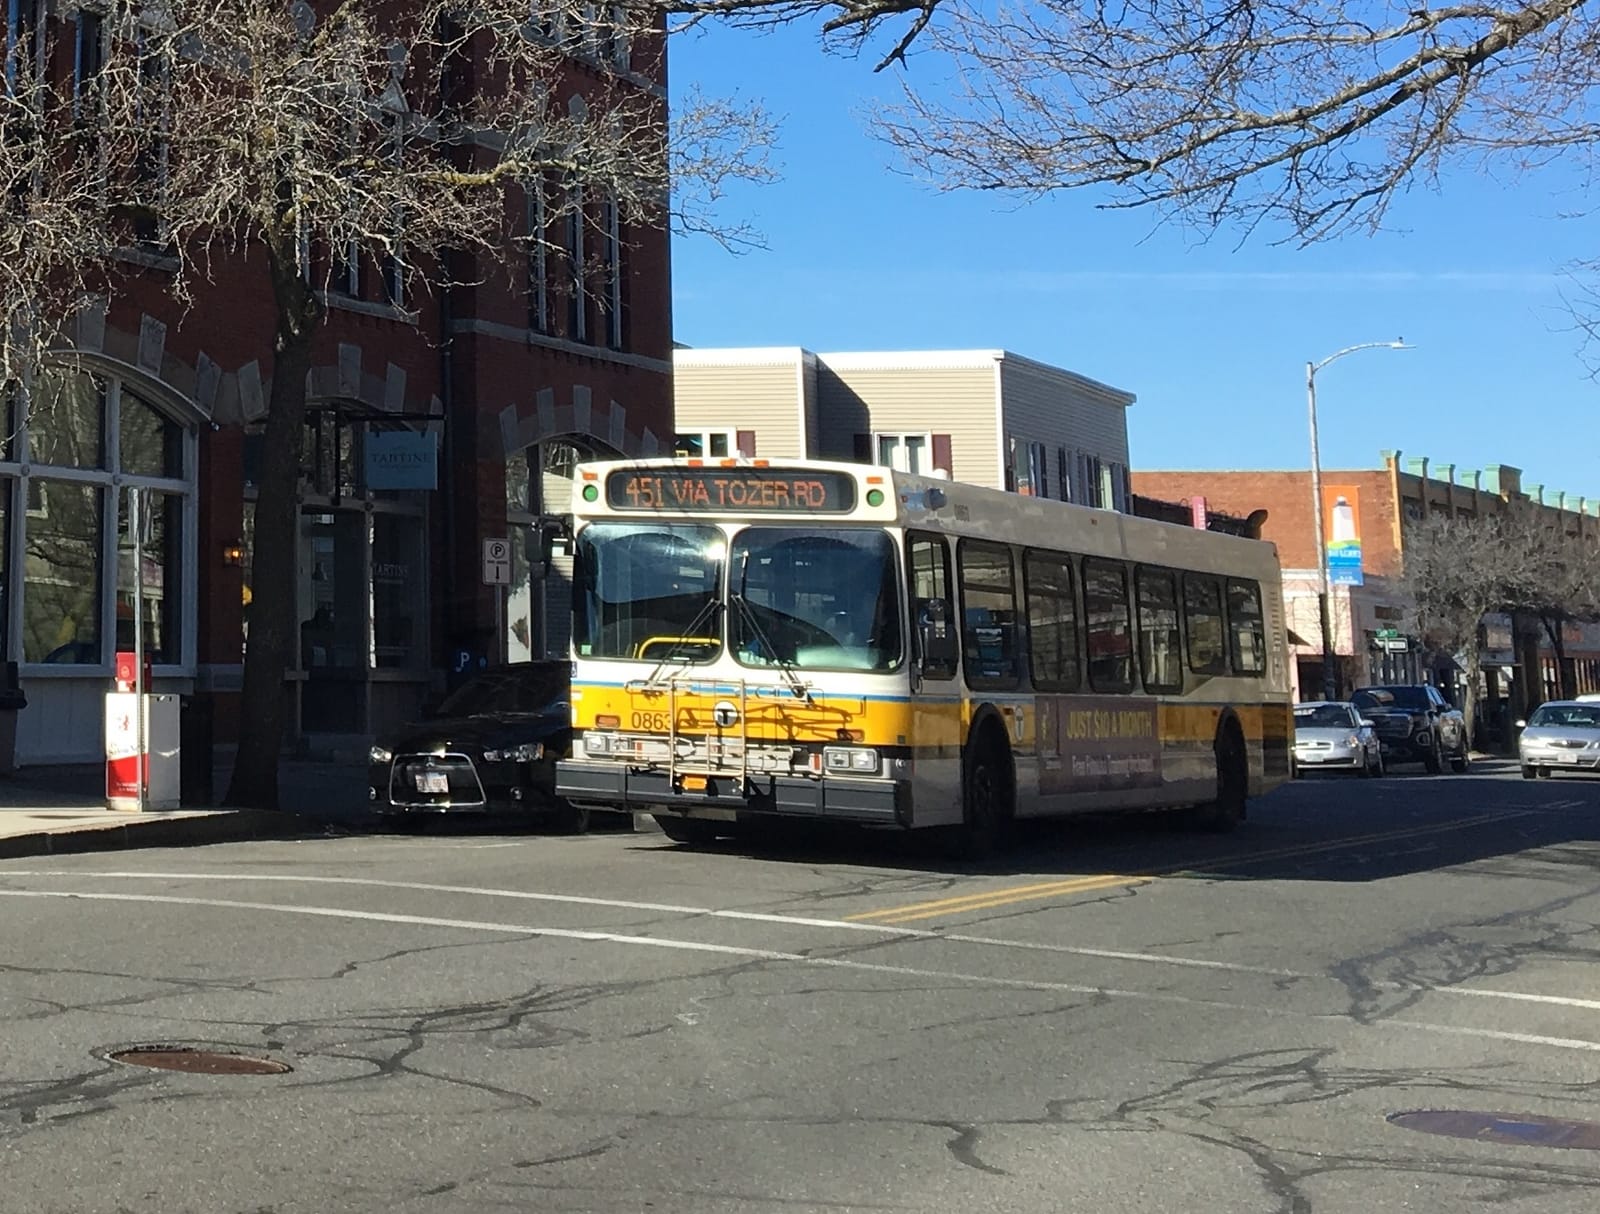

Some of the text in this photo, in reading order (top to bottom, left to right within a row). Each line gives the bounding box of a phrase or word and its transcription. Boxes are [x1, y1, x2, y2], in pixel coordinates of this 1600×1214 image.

[626, 477, 826, 507] 451 VIA TOZER RD
[1067, 711, 1092, 739] JUST
[1111, 711, 1118, 737] A
[1119, 711, 1152, 737] MONTH
